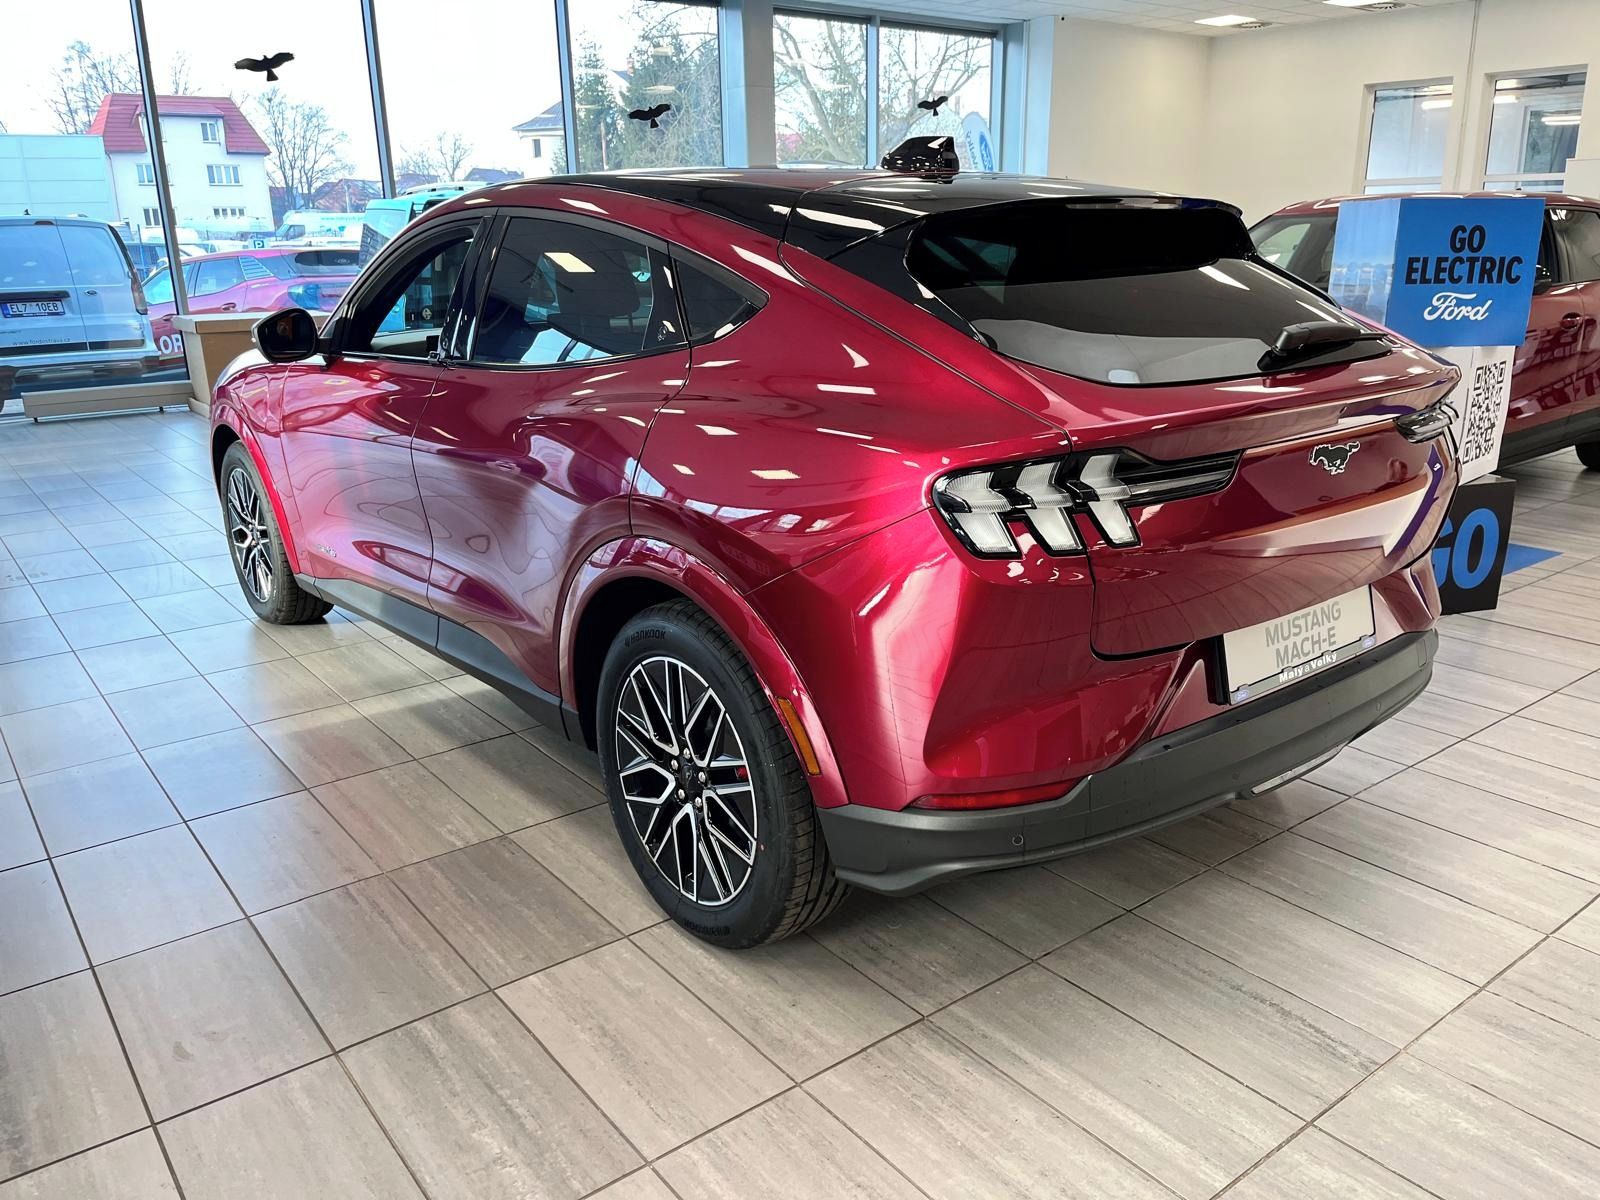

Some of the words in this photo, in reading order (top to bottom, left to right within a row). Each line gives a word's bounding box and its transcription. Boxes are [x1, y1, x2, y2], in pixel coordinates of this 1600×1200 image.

[1450, 225, 1486, 253] GO
[1405, 256, 1523, 285] ELECTRIC
[10, 303, 28, 313] EL7
[36, 302, 59, 312] 10EB
[1423, 291, 1492, 321] Ford
[1265, 601, 1342, 648] MUSTANG
[1275, 626, 1337, 669] MACH-E
[1304, 664, 1310, 673] a
